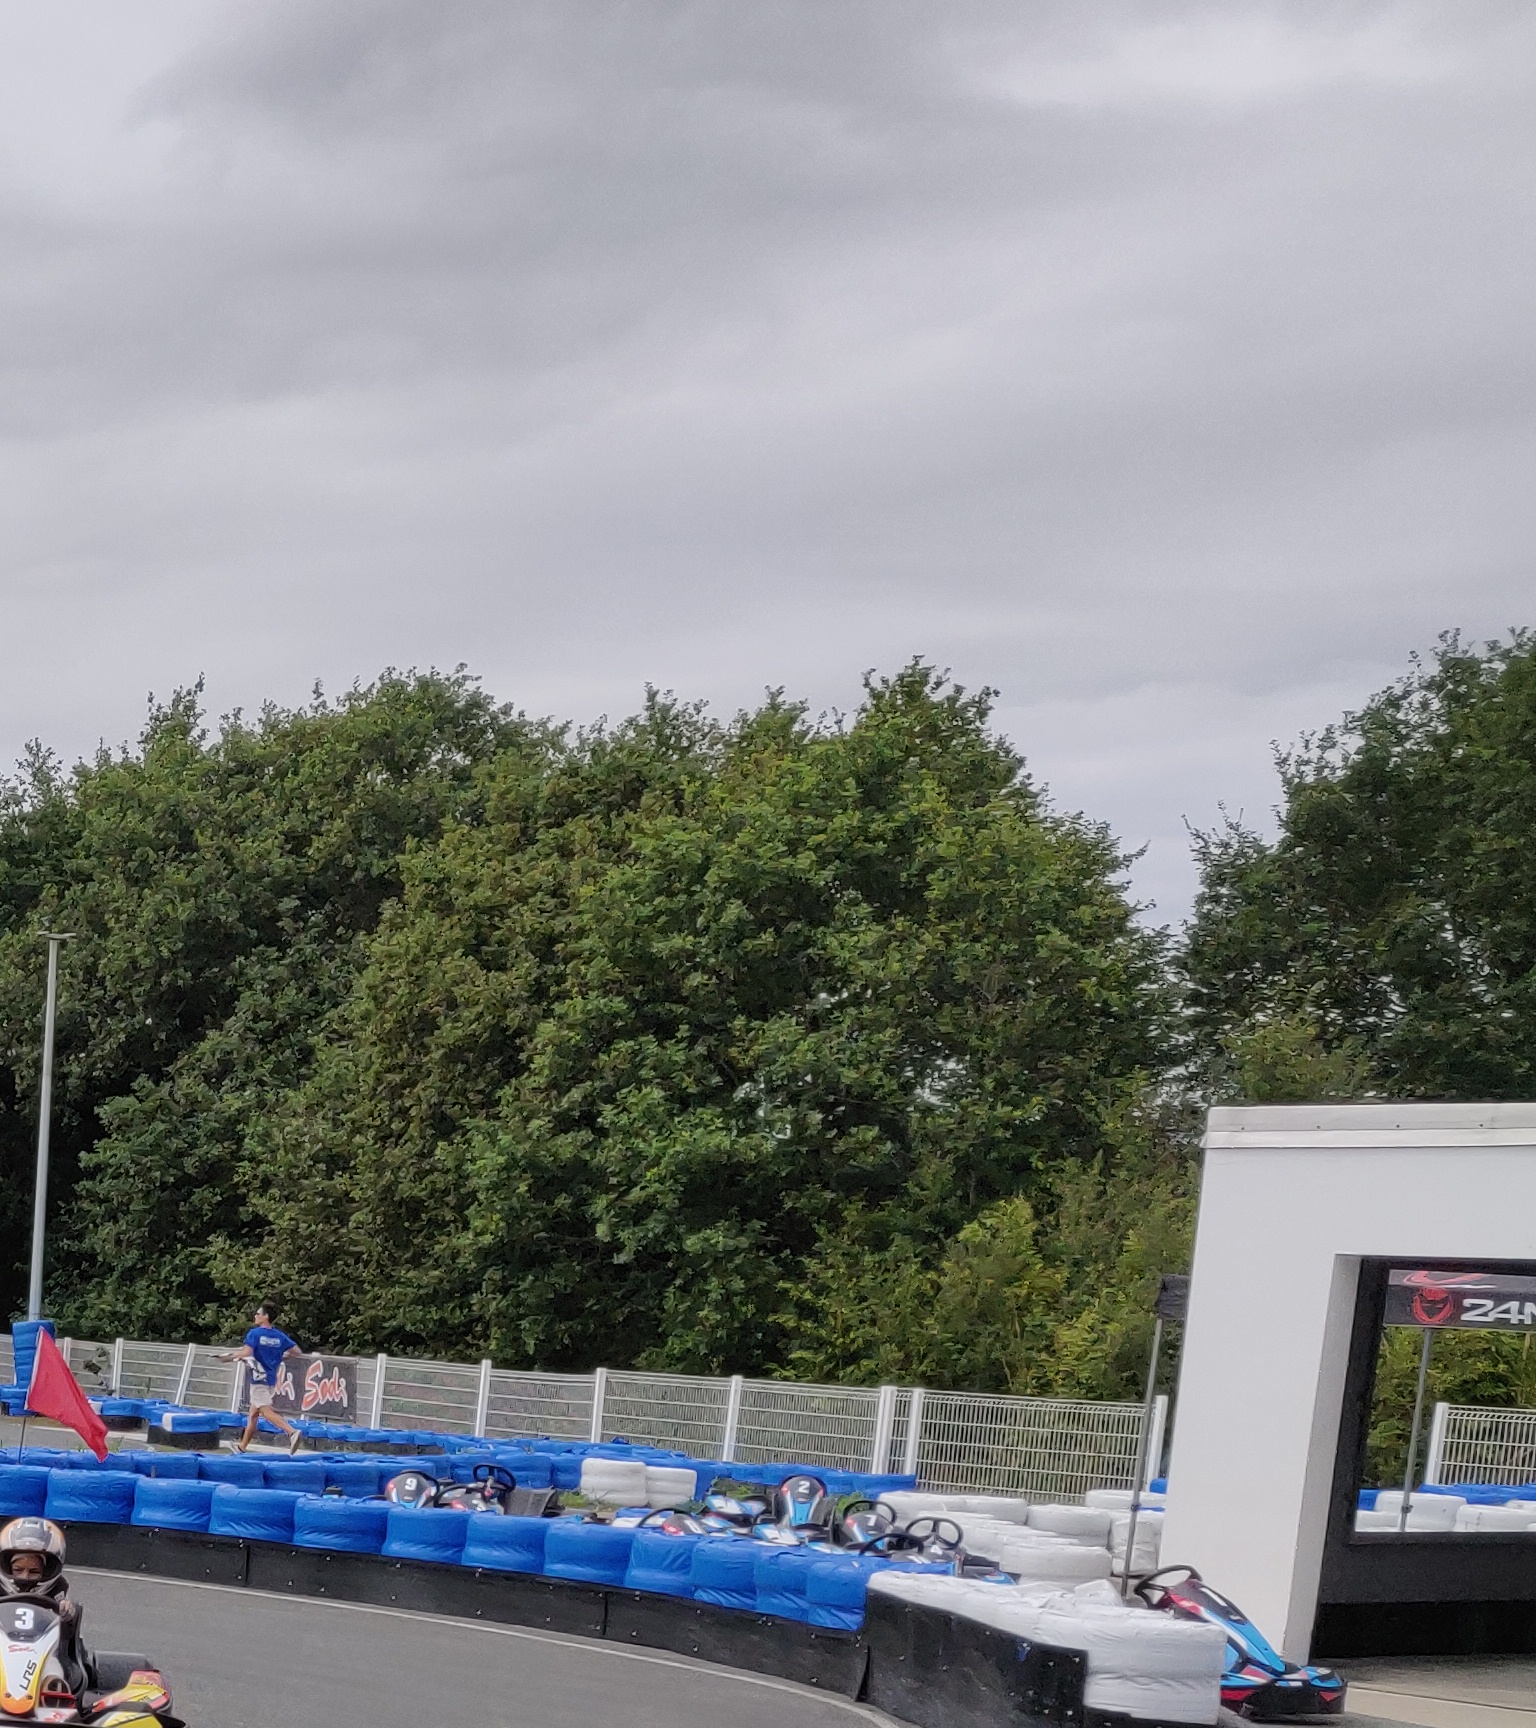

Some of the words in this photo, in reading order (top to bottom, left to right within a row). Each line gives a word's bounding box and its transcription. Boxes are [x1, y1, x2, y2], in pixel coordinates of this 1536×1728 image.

[301, 1360, 348, 1411] Sodi
[405, 1478, 418, 1491] 9
[798, 1480, 810, 1494] 2
[14, 1607, 34, 1630] 3
